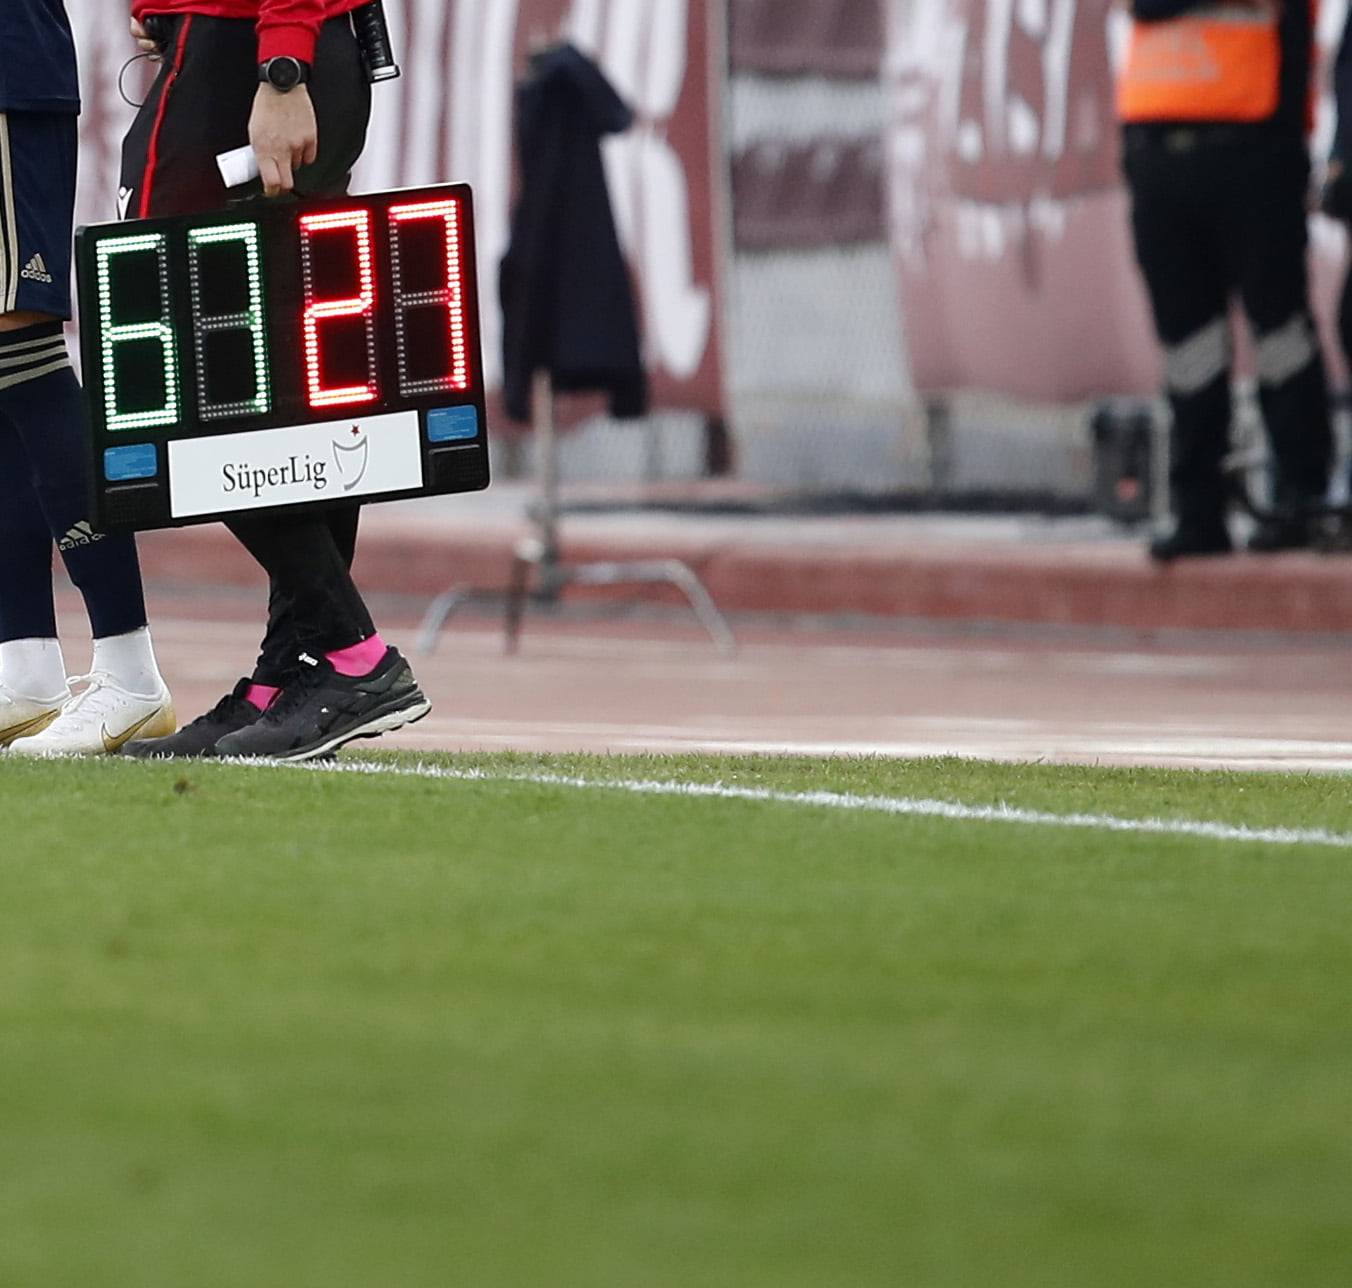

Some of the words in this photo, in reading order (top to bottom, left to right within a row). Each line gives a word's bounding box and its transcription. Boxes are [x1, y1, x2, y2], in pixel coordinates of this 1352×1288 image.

[20, 268, 53, 283] adidas
[95, 222, 271, 431] 67
[299, 199, 468, 407] 27
[222, 454, 328, 498] SüperLig
